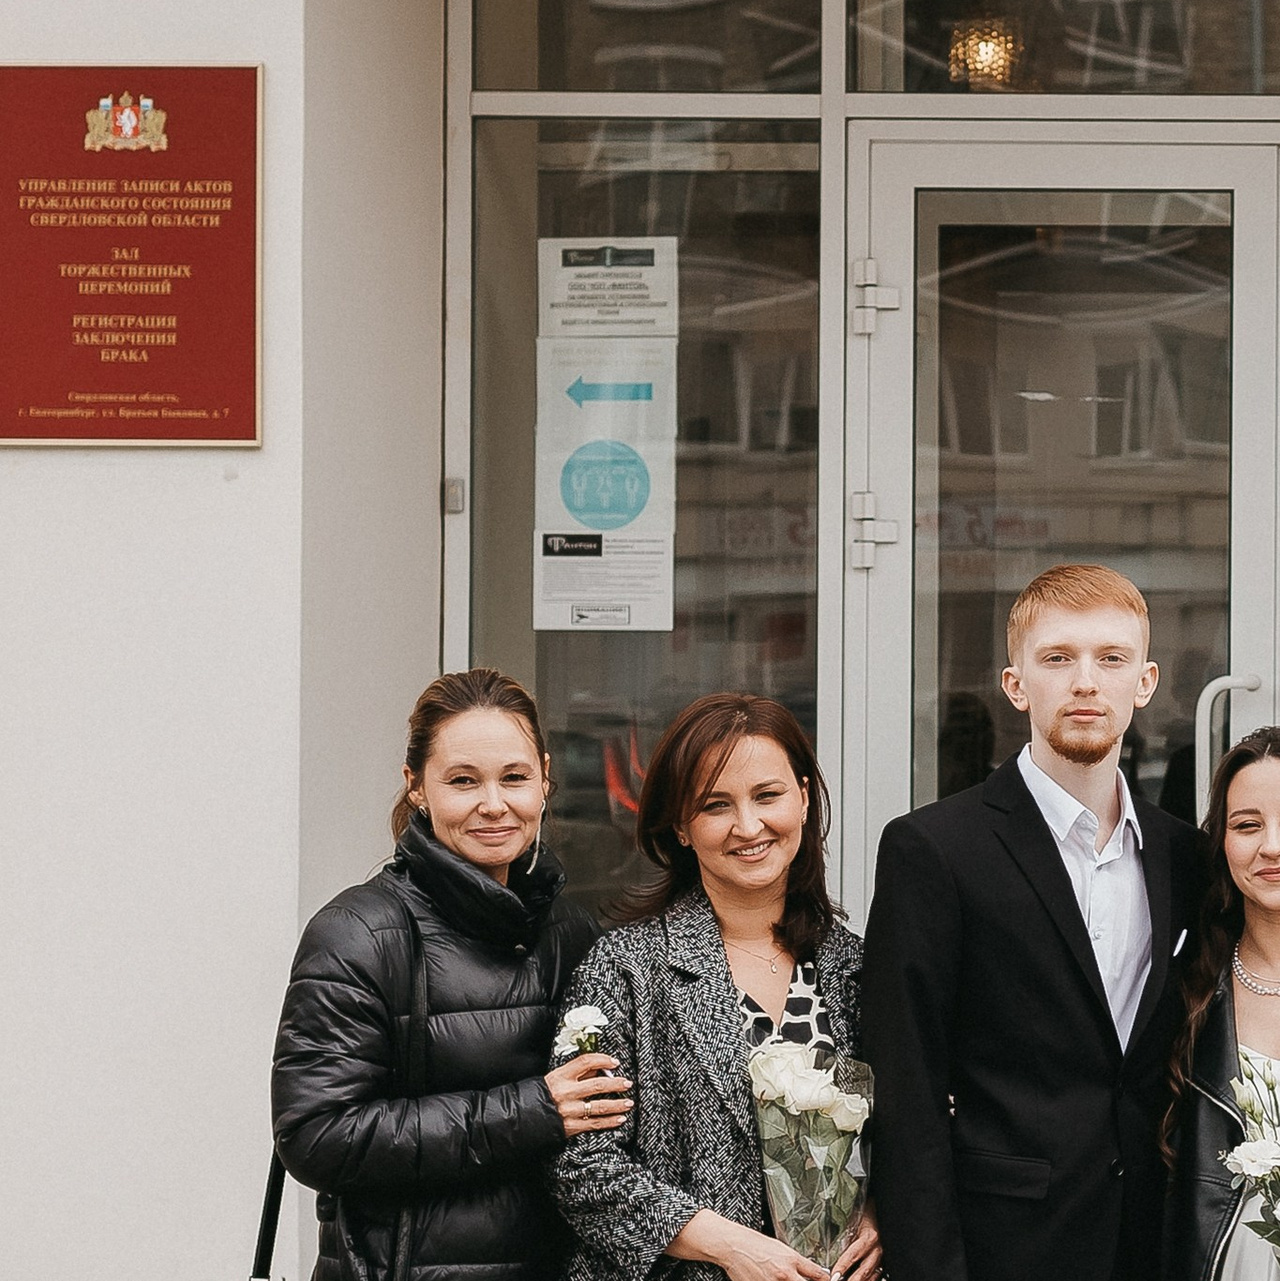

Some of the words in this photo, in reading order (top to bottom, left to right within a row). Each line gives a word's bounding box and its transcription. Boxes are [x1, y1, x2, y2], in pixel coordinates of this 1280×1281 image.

[18, 178, 117, 193] УПРАВЛЕНИЕ
[120, 178, 180, 193] ЗАПИСИ
[183, 179, 233, 194] АКТОВ
[18, 195, 138, 210] ГРАЖДАНСКОГО
[142, 196, 232, 211] СОСТОЯНИЯ
[30, 211, 148, 227] СВЕРДЛОВСКОЙ
[151, 213, 220, 228] ОБЛАСТИ
[111, 247, 140, 261] ЗАЛ
[59, 263, 192, 278] ТОРЖЕСТВЕННЫХ
[78, 278, 172, 295] ЦЕРЕМОНИЙ
[72, 314, 177, 329] РЕГИСТРАЦИЯ
[72, 331, 177, 346] ЗАКЛЮЧЕНИЯ
[100, 348, 149, 363] БРАКА
[223, 408, 230, 418] 7
